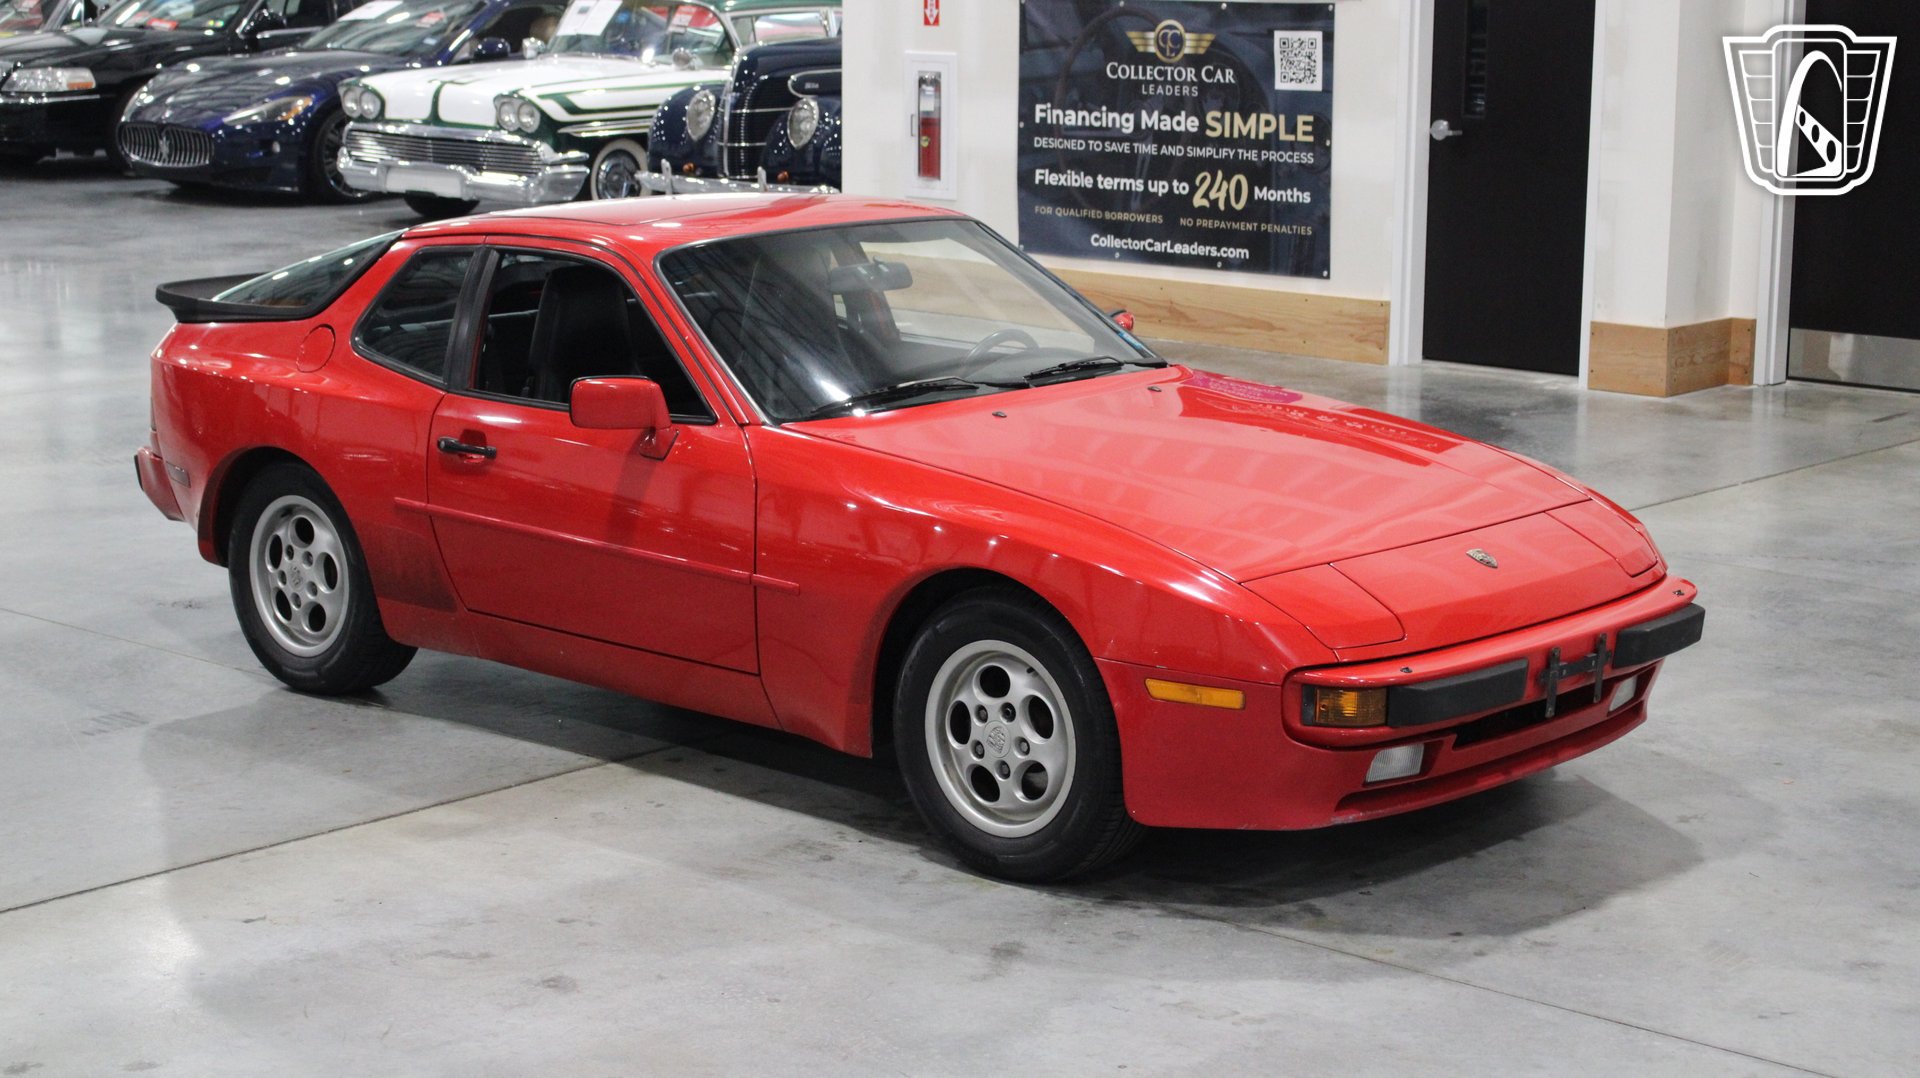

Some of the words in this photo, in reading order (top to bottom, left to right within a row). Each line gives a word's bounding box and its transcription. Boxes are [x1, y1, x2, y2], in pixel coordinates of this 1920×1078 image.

[1106, 61, 1198, 82] COLLECTOR
[1201, 65, 1236, 83] CAR
[1142, 84, 1199, 97] LEADERS
[1035, 102, 1135, 134] Financing
[1141, 109, 1200, 133] Made
[1205, 110, 1315, 142] SIMPLE
[1034, 136, 1085, 150] DESIGNED
[1088, 140, 1103, 151] TO
[1104, 141, 1131, 153] SAVE
[1133, 142, 1158, 155] TIME
[1160, 144, 1185, 157] AND
[1186, 146, 1236, 160] SIMPLIFY
[1237, 148, 1259, 161] THE
[1261, 150, 1314, 164] PROCESS
[1034, 168, 1094, 189] Flexible
[1096, 174, 1145, 192] terms
[1148, 178, 1169, 197] up
[1172, 178, 1190, 195] to
[1192, 169, 1249, 212] 240
[1254, 185, 1311, 204] Months
[1034, 205, 1053, 216] FOR
[1055, 207, 1103, 219] QUALIFIED
[1104, 210, 1164, 224] BORROWERS
[1180, 217, 1193, 227] NO
[1196, 218, 1258, 232] PREPAYMENT
[1260, 223, 1313, 236] PENALTIES
[1090, 233, 1250, 260] CollectorCarLeaders.com
